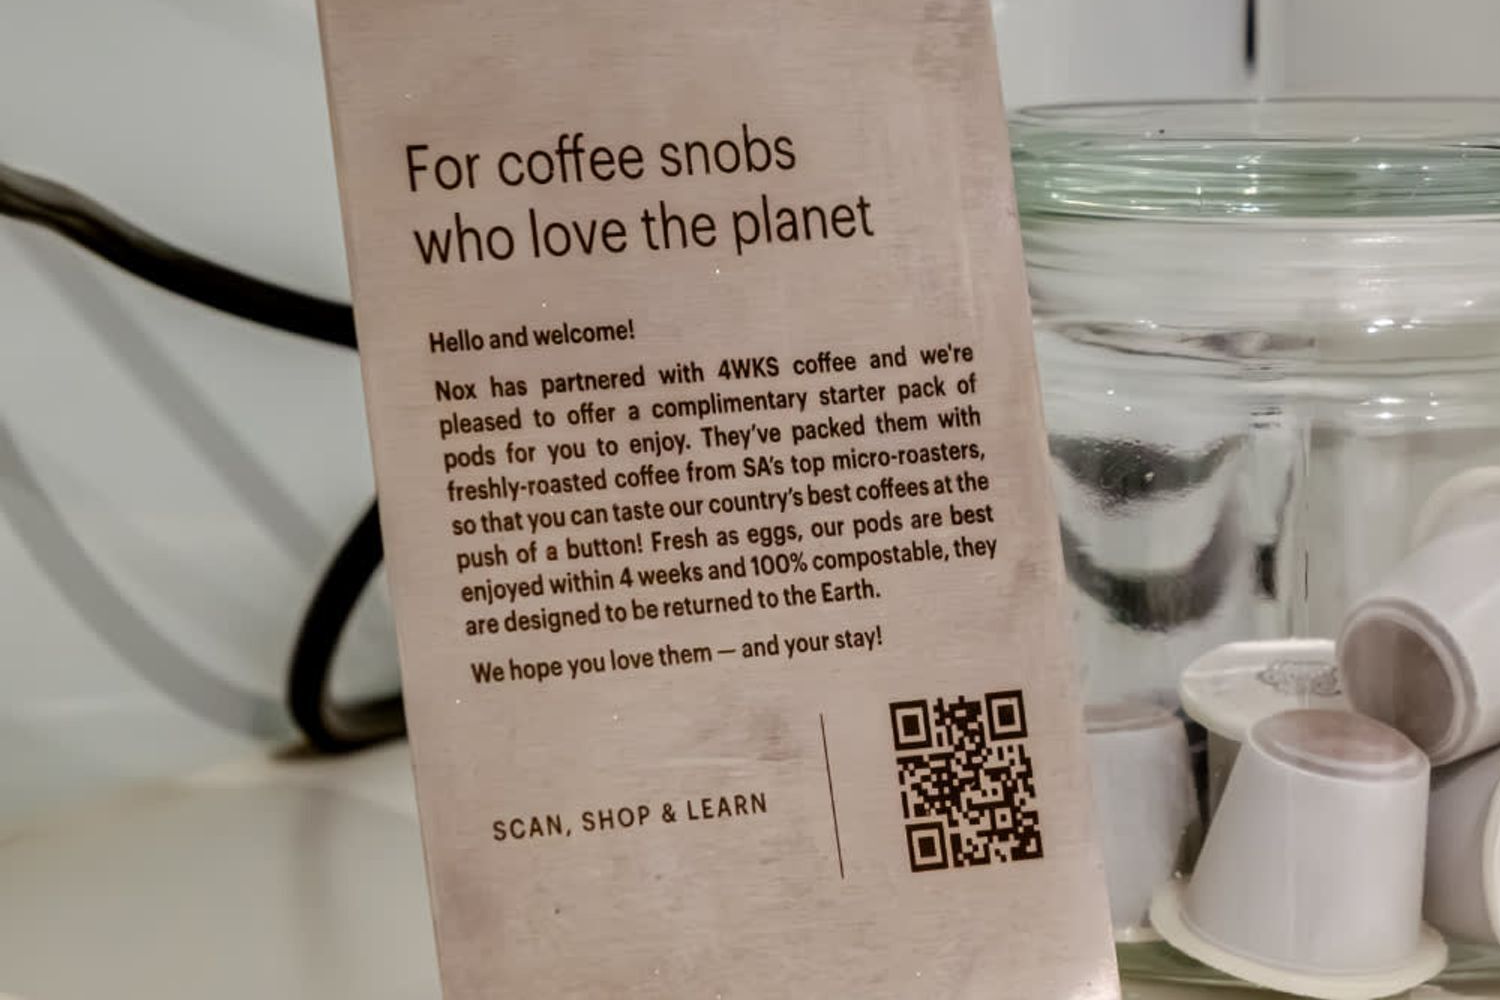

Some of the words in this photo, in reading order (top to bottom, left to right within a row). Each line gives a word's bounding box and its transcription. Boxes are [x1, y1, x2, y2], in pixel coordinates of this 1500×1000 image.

[406, 144, 480, 192] For
[498, 132, 644, 186] coffee
[660, 123, 796, 177] snobs
[413, 212, 514, 265] who
[529, 208, 627, 258] love
[641, 200, 716, 251] the
[732, 194, 874, 256] planet
[429, 329, 484, 353] Hello
[489, 325, 529, 349] and
[533, 319, 635, 346] welcome!
[435, 380, 477, 402] Nox
[490, 375, 527, 397] has
[541, 365, 645, 399] partnered
[658, 361, 704, 385] with
[718, 356, 779, 380] 4WKS
[793, 351, 857, 375] coffee
[870, 345, 907, 369] and
[439, 407, 522, 440] pleased
[533, 409, 555, 428] to
[567, 402, 616, 425] offer
[628, 405, 640, 421] a
[652, 391, 807, 420] complimentary
[819, 384, 885, 406] starter
[898, 375, 946, 404] pack
[957, 372, 977, 395] of
[444, 444, 496, 474] pods
[506, 442, 536, 464] for
[547, 442, 586, 465] you
[596, 438, 618, 456] to
[629, 431, 691, 457] enjoy.
[792, 414, 865, 446] packed
[875, 412, 928, 434] them
[937, 405, 981, 429] with
[447, 468, 607, 502] freshly-roasted
[615, 464, 680, 488] coffee
[686, 461, 736, 483] from
[791, 455, 825, 477] top
[832, 443, 985, 471] micro-roasters,
[452, 518, 476, 535] so
[480, 511, 524, 533] that
[527, 511, 565, 534] you
[570, 508, 608, 525] can
[612, 501, 664, 522] taste
[669, 500, 703, 517] our
[807, 484, 852, 505] best
[856, 477, 929, 501] coffees
[934, 476, 953, 495] at
[956, 470, 989, 493] the
[457, 544, 508, 574] push
[516, 541, 537, 563] of
[546, 546, 558, 561] a
[566, 533, 643, 559] button!
[651, 526, 708, 552] Fresh
[717, 530, 739, 546] as
[747, 525, 803, 547] eggs,
[811, 521, 844, 538] our
[853, 510, 903, 539] pods
[911, 512, 943, 529] are
[950, 504, 994, 525] best
[461, 574, 544, 605] enjoyed
[549, 569, 614, 594] within
[620, 567, 634, 588] 4
[637, 561, 703, 586] weeks
[708, 556, 746, 580] and
[750, 552, 808, 576] 100%
[812, 539, 949, 572] compostable,
[953, 536, 997, 560] they
[466, 618, 499, 636] are
[504, 602, 601, 633] designed
[605, 604, 627, 622] to
[631, 598, 659, 620] be
[663, 588, 753, 617] returned
[757, 591, 779, 608] to
[783, 584, 816, 606] the
[821, 578, 881, 603] Earth.
[471, 662, 505, 684] We
[509, 658, 563, 683] hope
[567, 656, 605, 679] you
[610, 649, 654, 670] love
[658, 644, 712, 666] them
[742, 634, 779, 658] and
[784, 635, 829, 659] your
[835, 625, 882, 651] stay!
[493, 814, 571, 841] SCAN,
[582, 805, 650, 832] SHOP
[662, 803, 677, 823] &
[687, 793, 766, 820] LEARN
